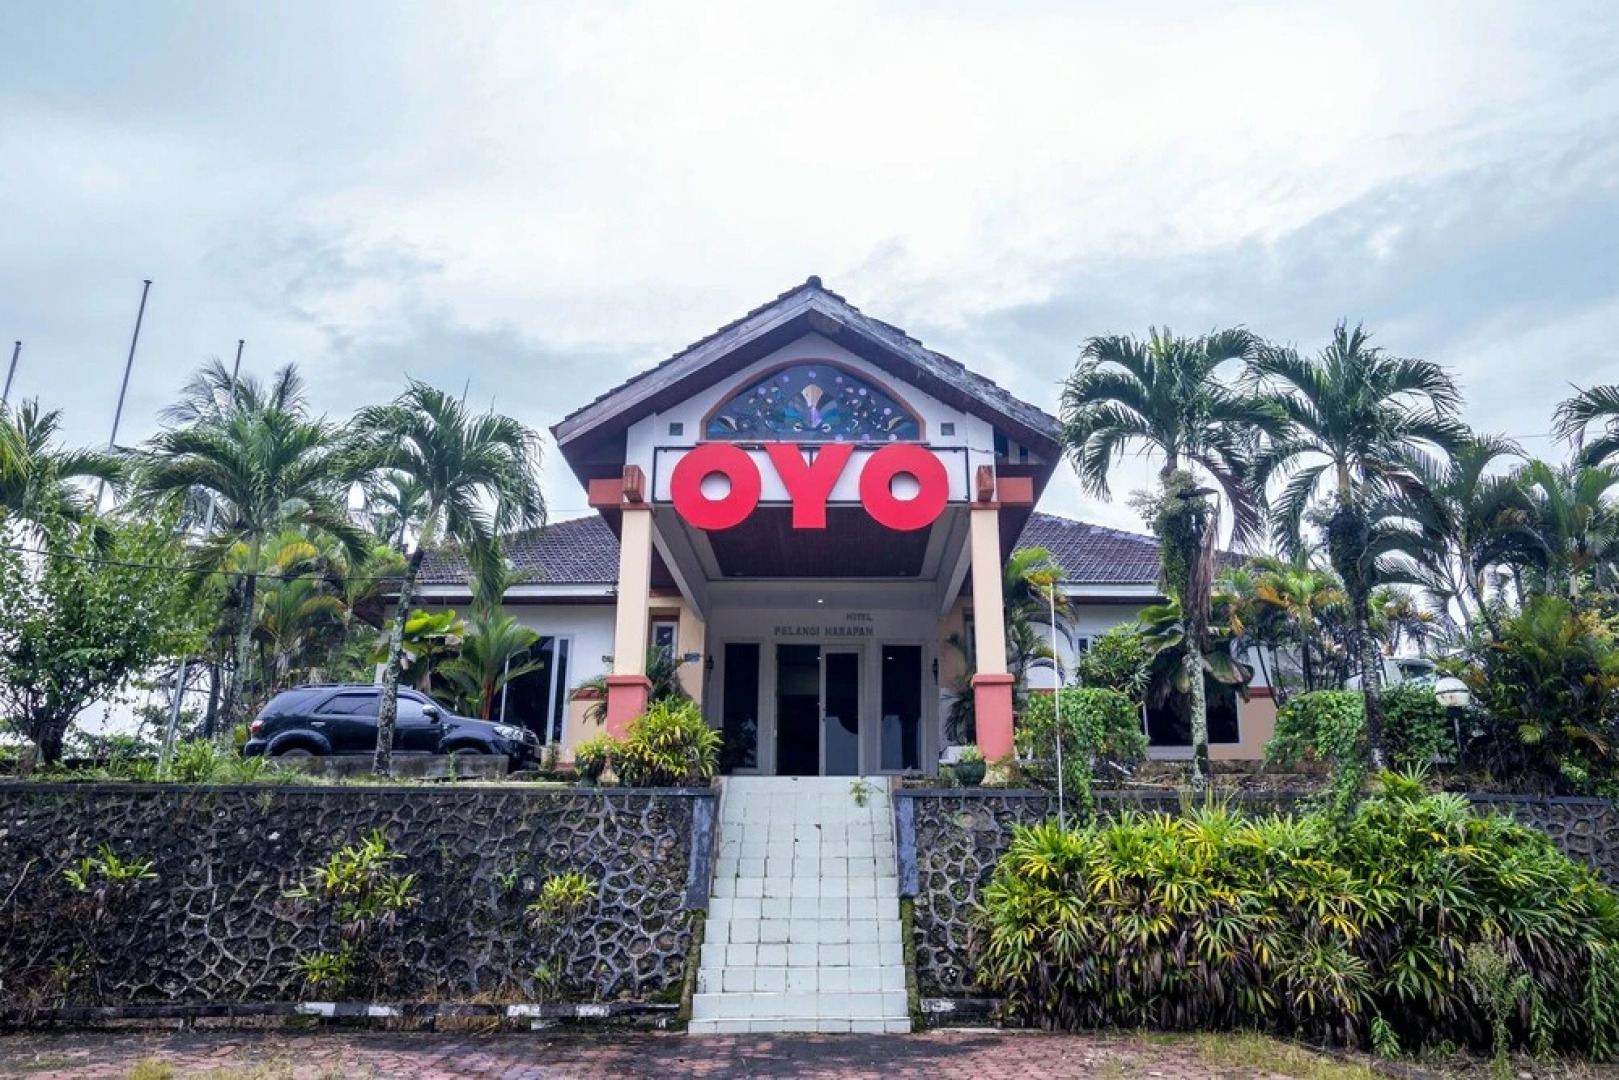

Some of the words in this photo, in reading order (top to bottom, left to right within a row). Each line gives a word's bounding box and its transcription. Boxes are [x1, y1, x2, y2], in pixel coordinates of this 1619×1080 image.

[670, 442, 949, 530] OYO
[846, 612, 873, 621] HOTEL
[774, 626, 820, 636] PELANGI
[825, 626, 874, 637] HARAPAN
